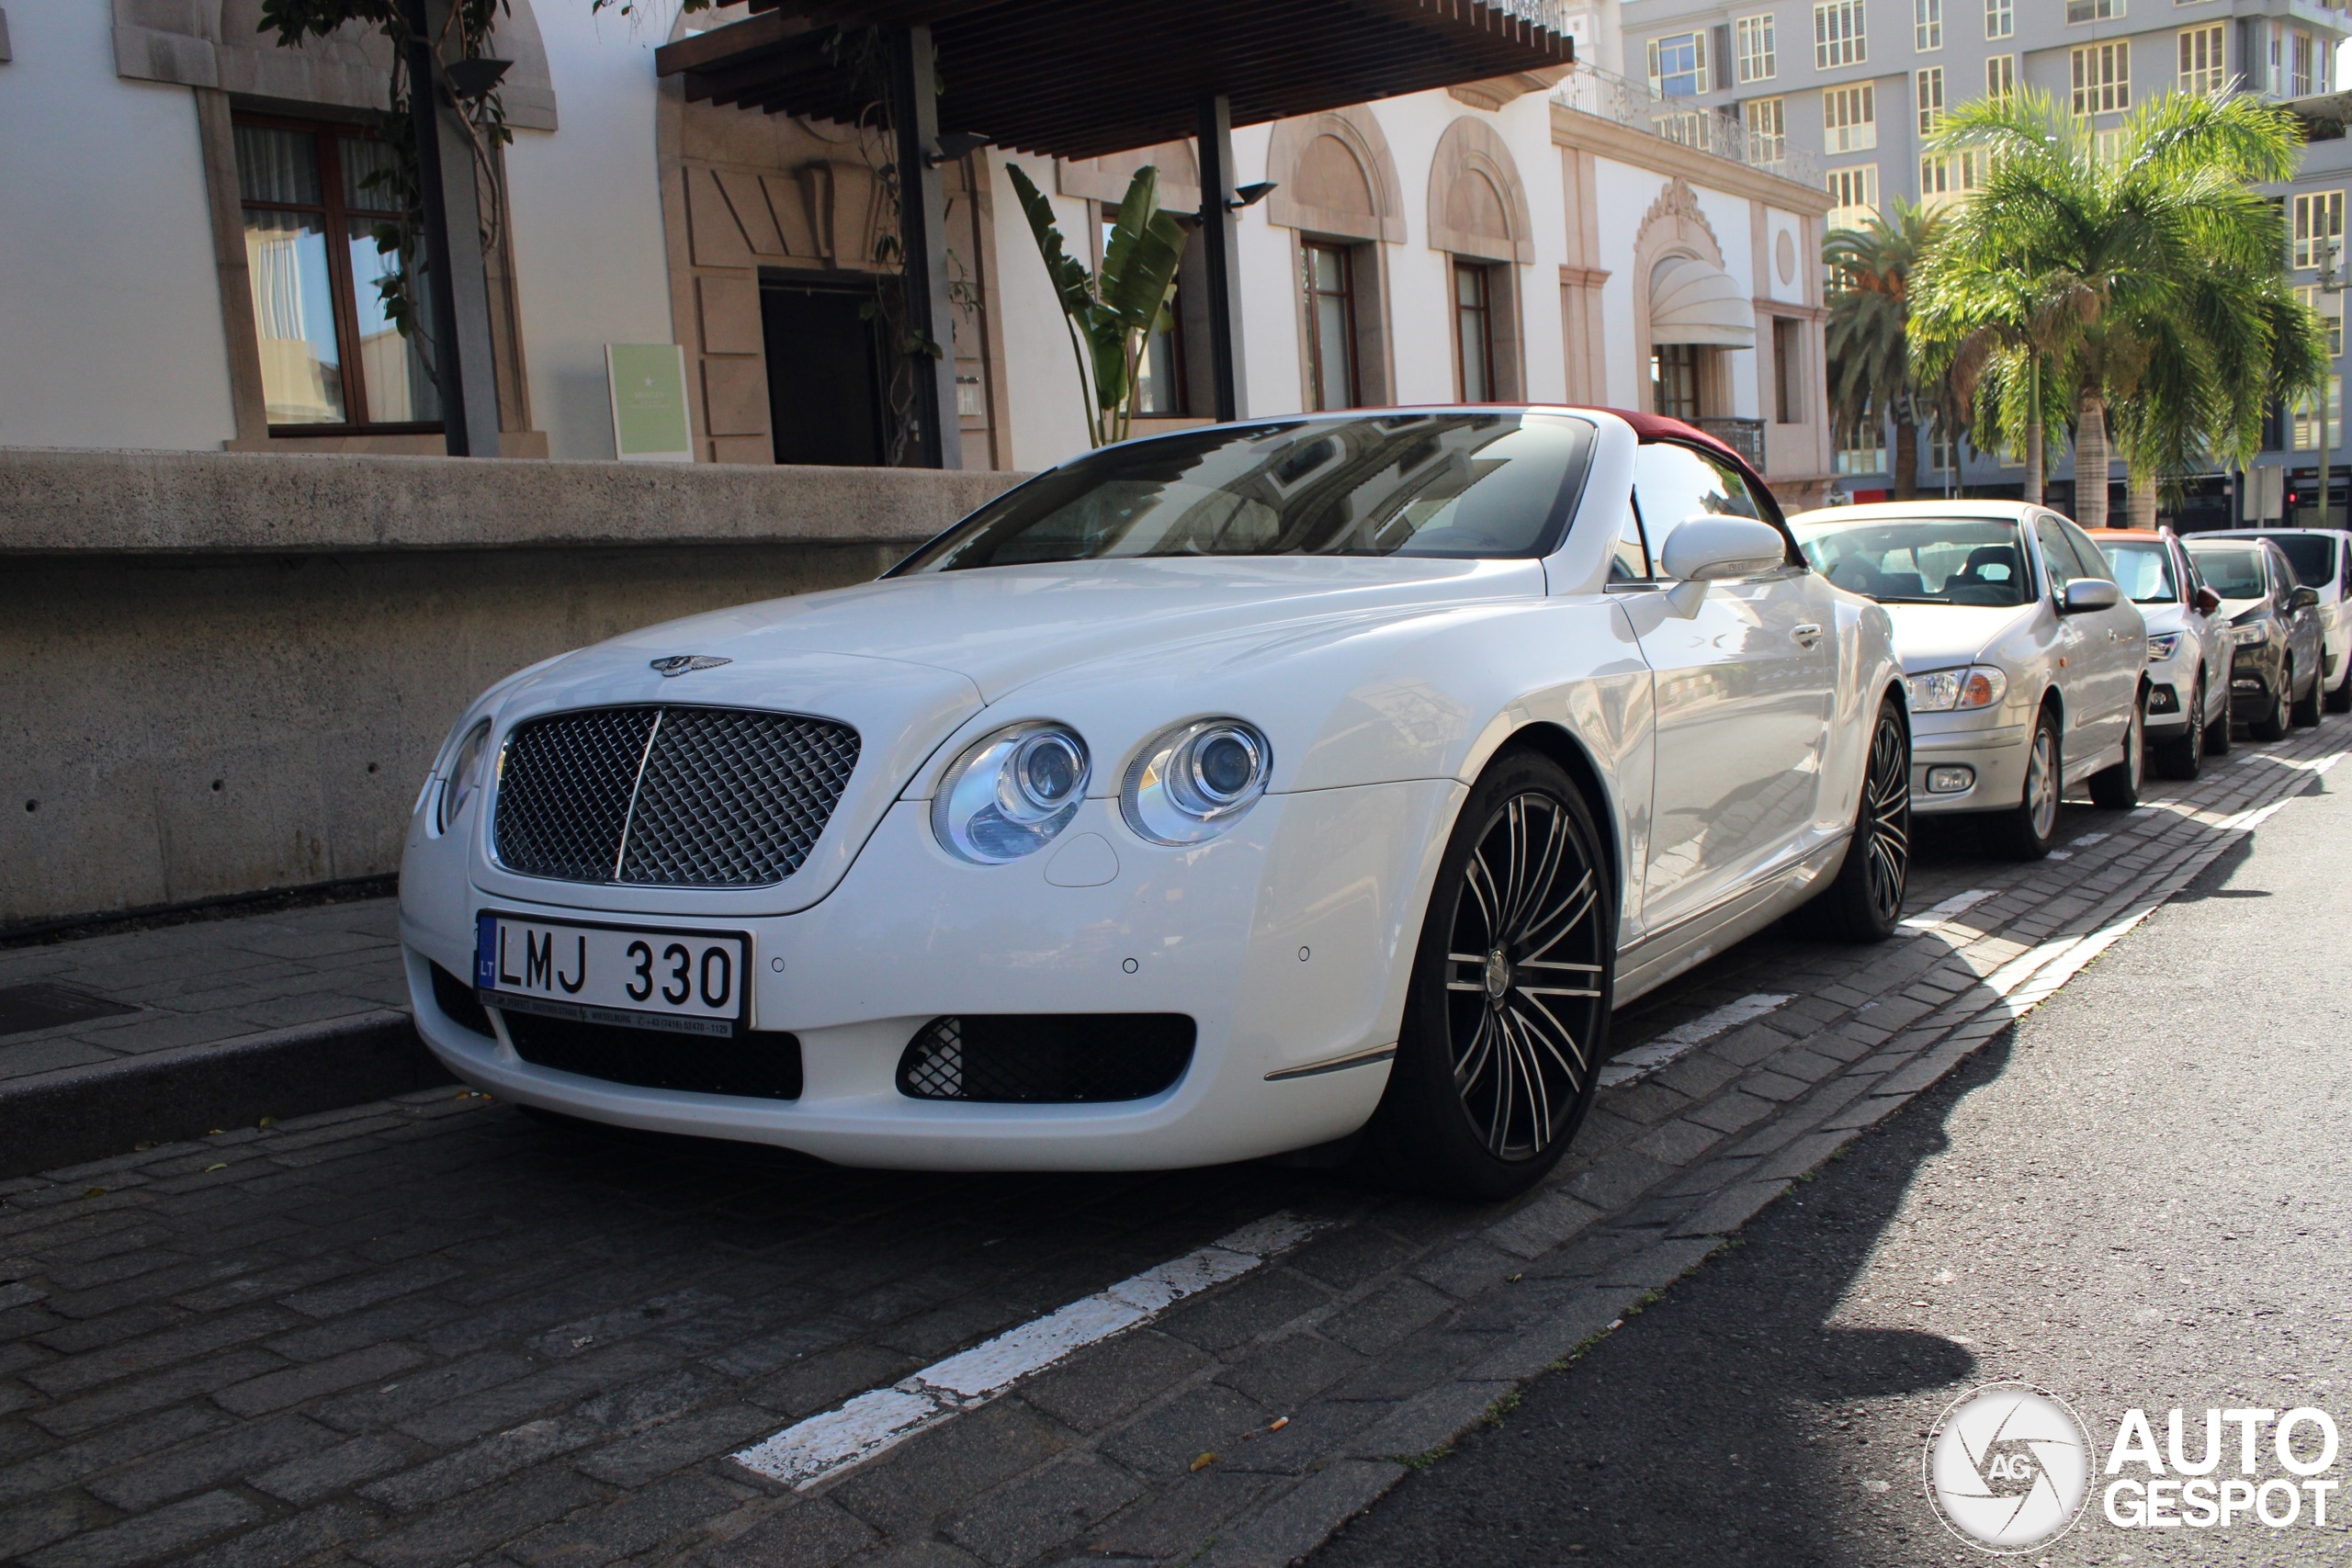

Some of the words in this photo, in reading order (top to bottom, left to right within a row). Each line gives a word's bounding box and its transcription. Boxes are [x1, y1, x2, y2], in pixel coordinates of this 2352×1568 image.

[480, 960, 493, 976] LT
[500, 926, 586, 994] LMJ
[626, 940, 731, 1009] 330
[711, 1024, 728, 1034] 1129
